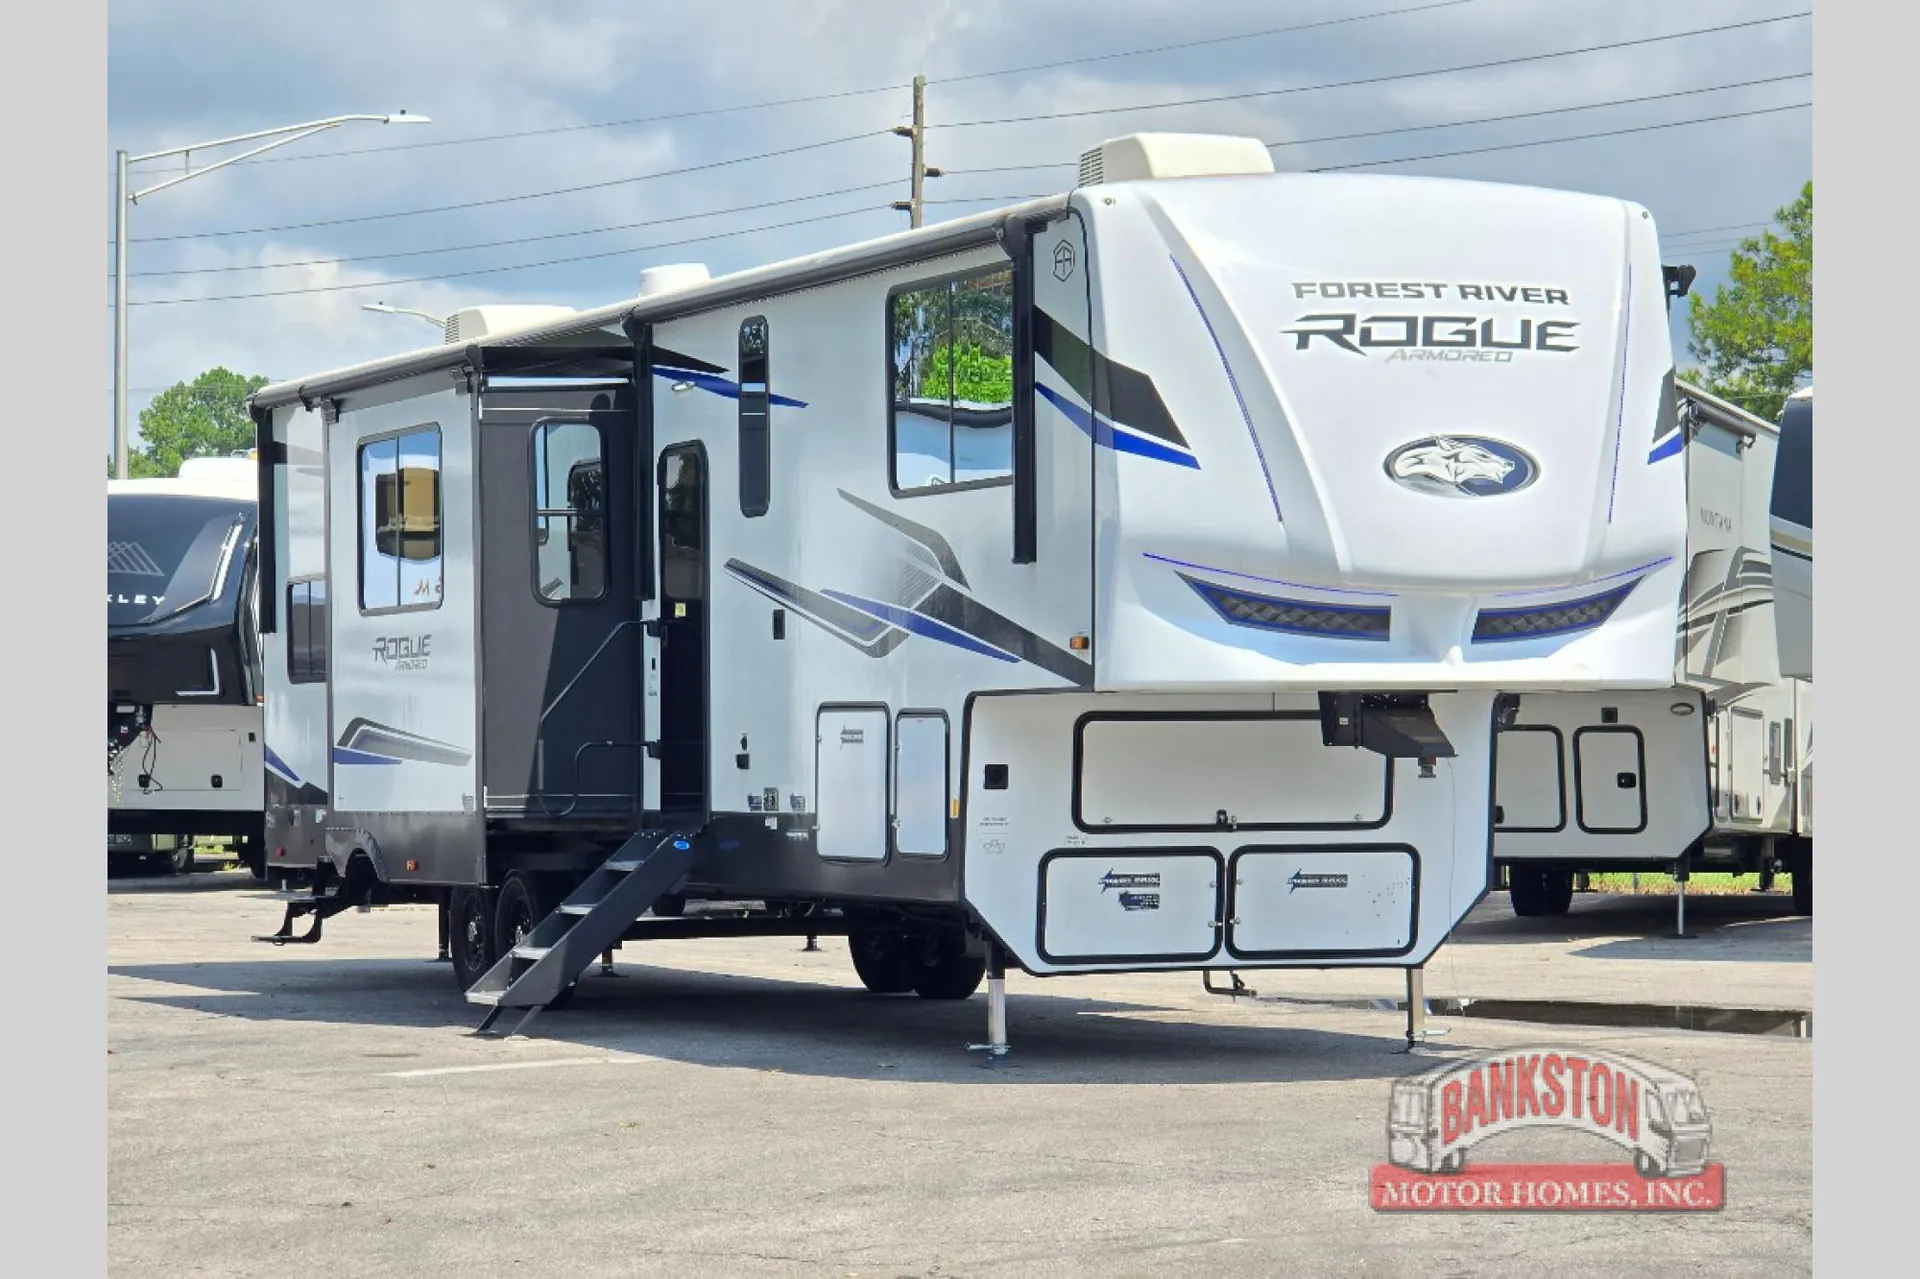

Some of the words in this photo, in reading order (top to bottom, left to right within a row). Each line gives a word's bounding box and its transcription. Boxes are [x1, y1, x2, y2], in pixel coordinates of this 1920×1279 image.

[1292, 282, 1448, 300] FOREST
[1457, 284, 1570, 305] RIVER
[1279, 313, 1581, 356] ROGUE
[1384, 347, 1514, 364] ARMORED
[372, 634, 432, 665] ROGUE
